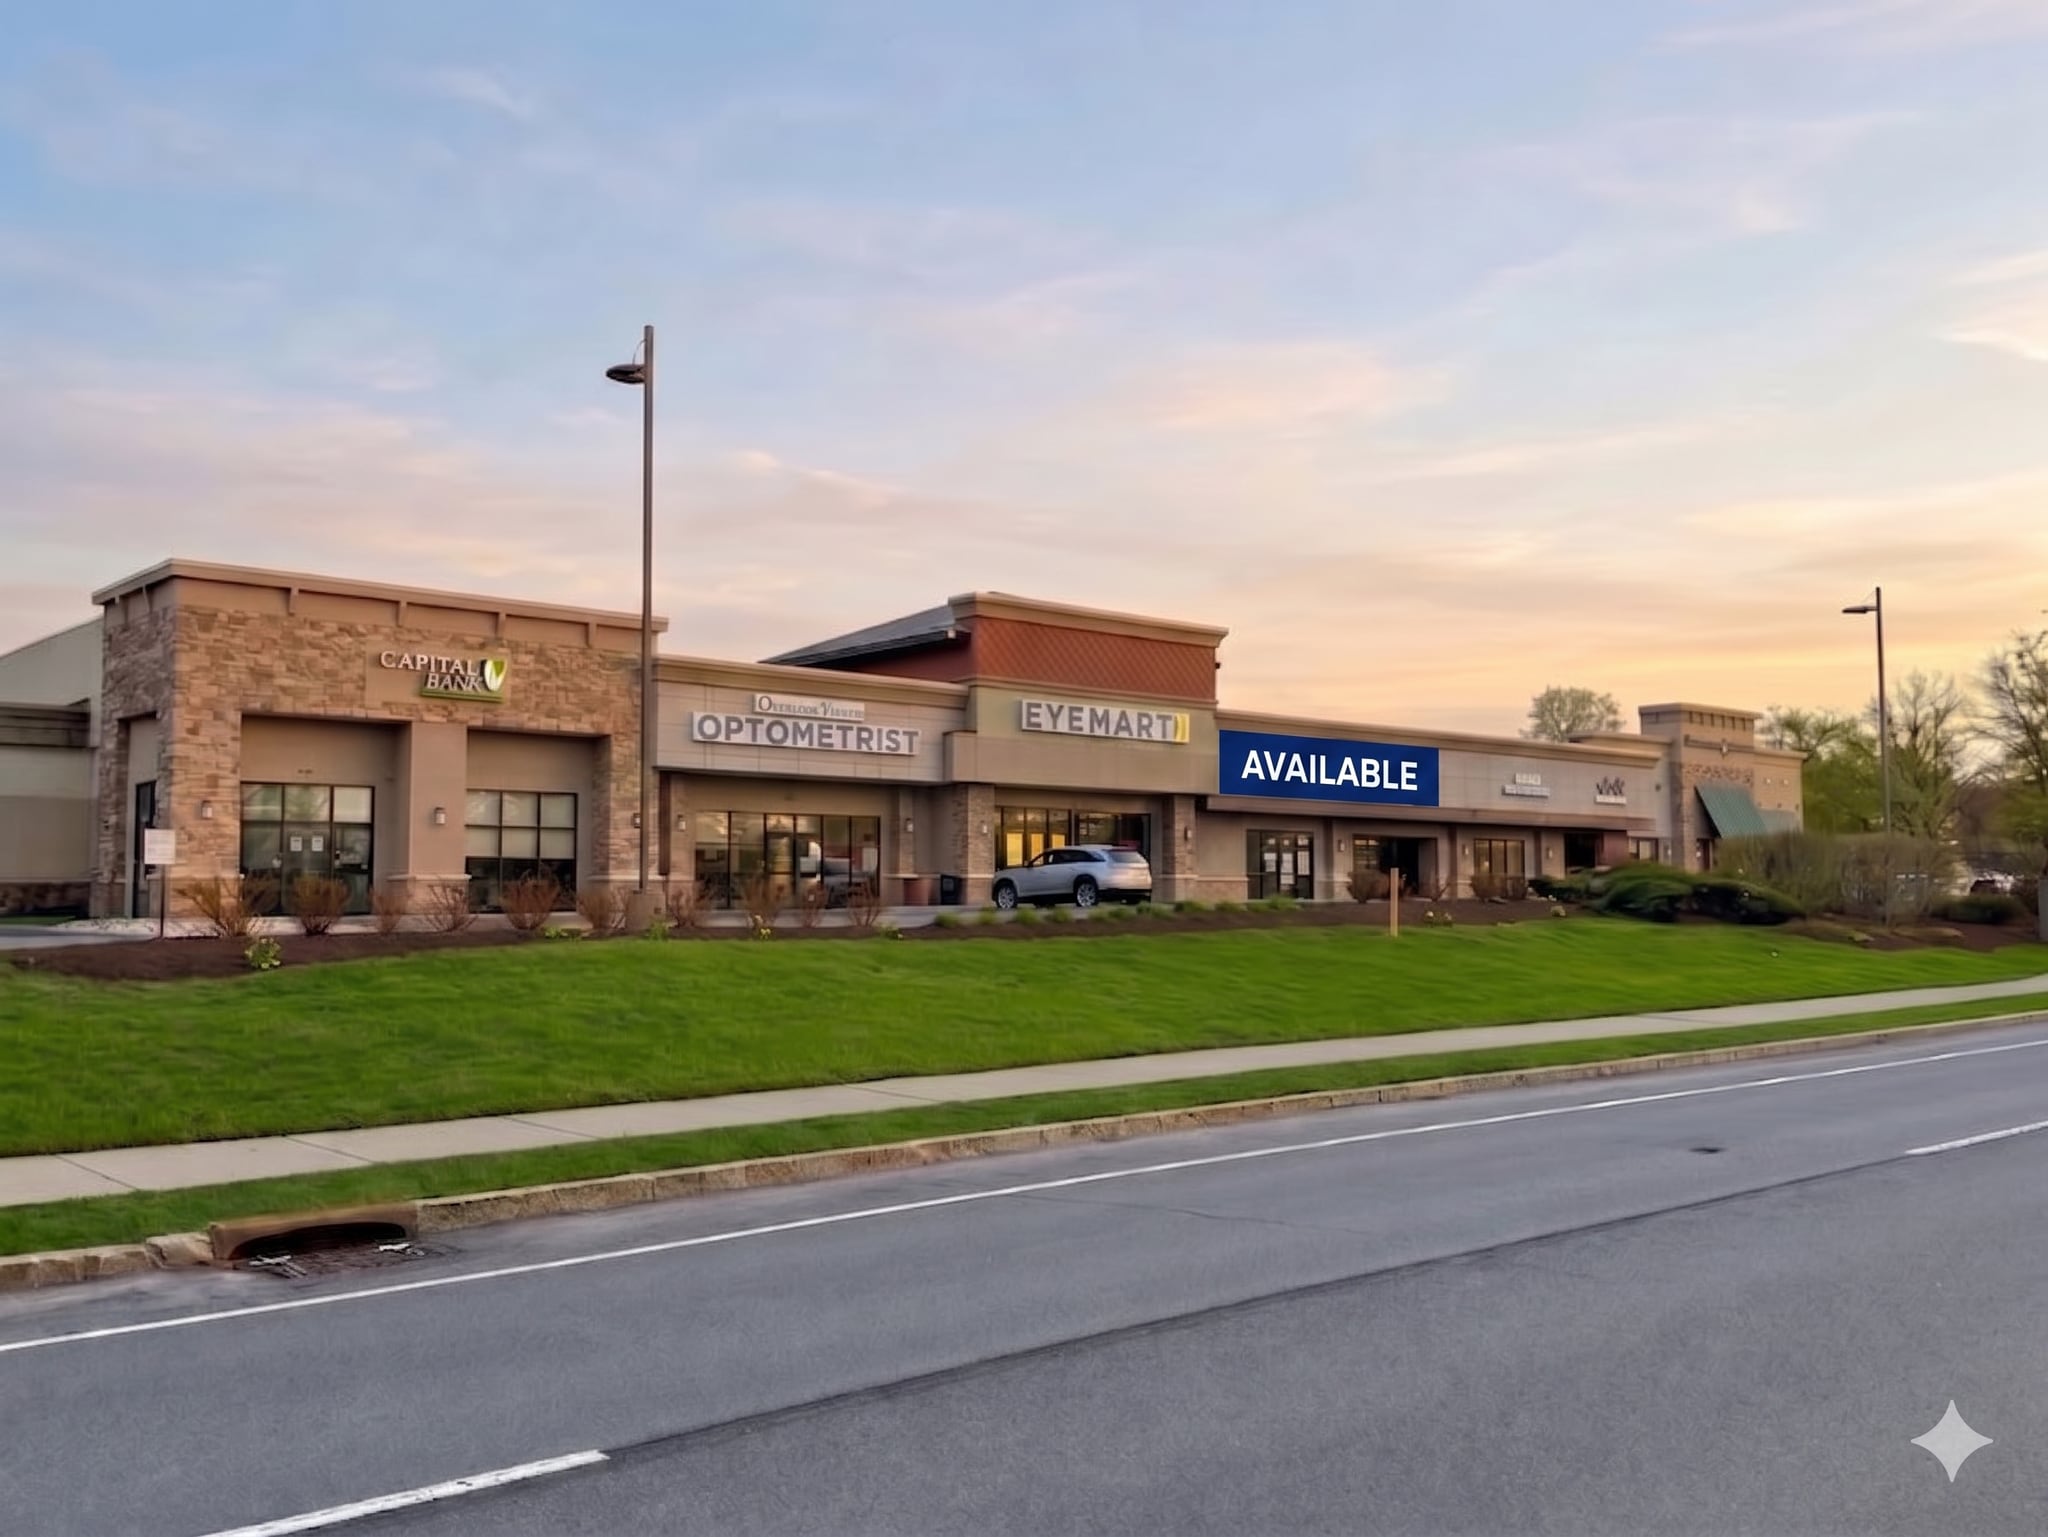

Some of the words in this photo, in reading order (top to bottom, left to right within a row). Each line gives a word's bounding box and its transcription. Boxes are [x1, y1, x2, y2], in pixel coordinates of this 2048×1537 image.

[380, 650, 479, 676] CAPITAL
[426, 672, 482, 692] BANK
[697, 714, 919, 753] OPTOMETRIST
[1025, 702, 1173, 739] EYEMART
[1241, 750, 1418, 791] AVAILABLE
